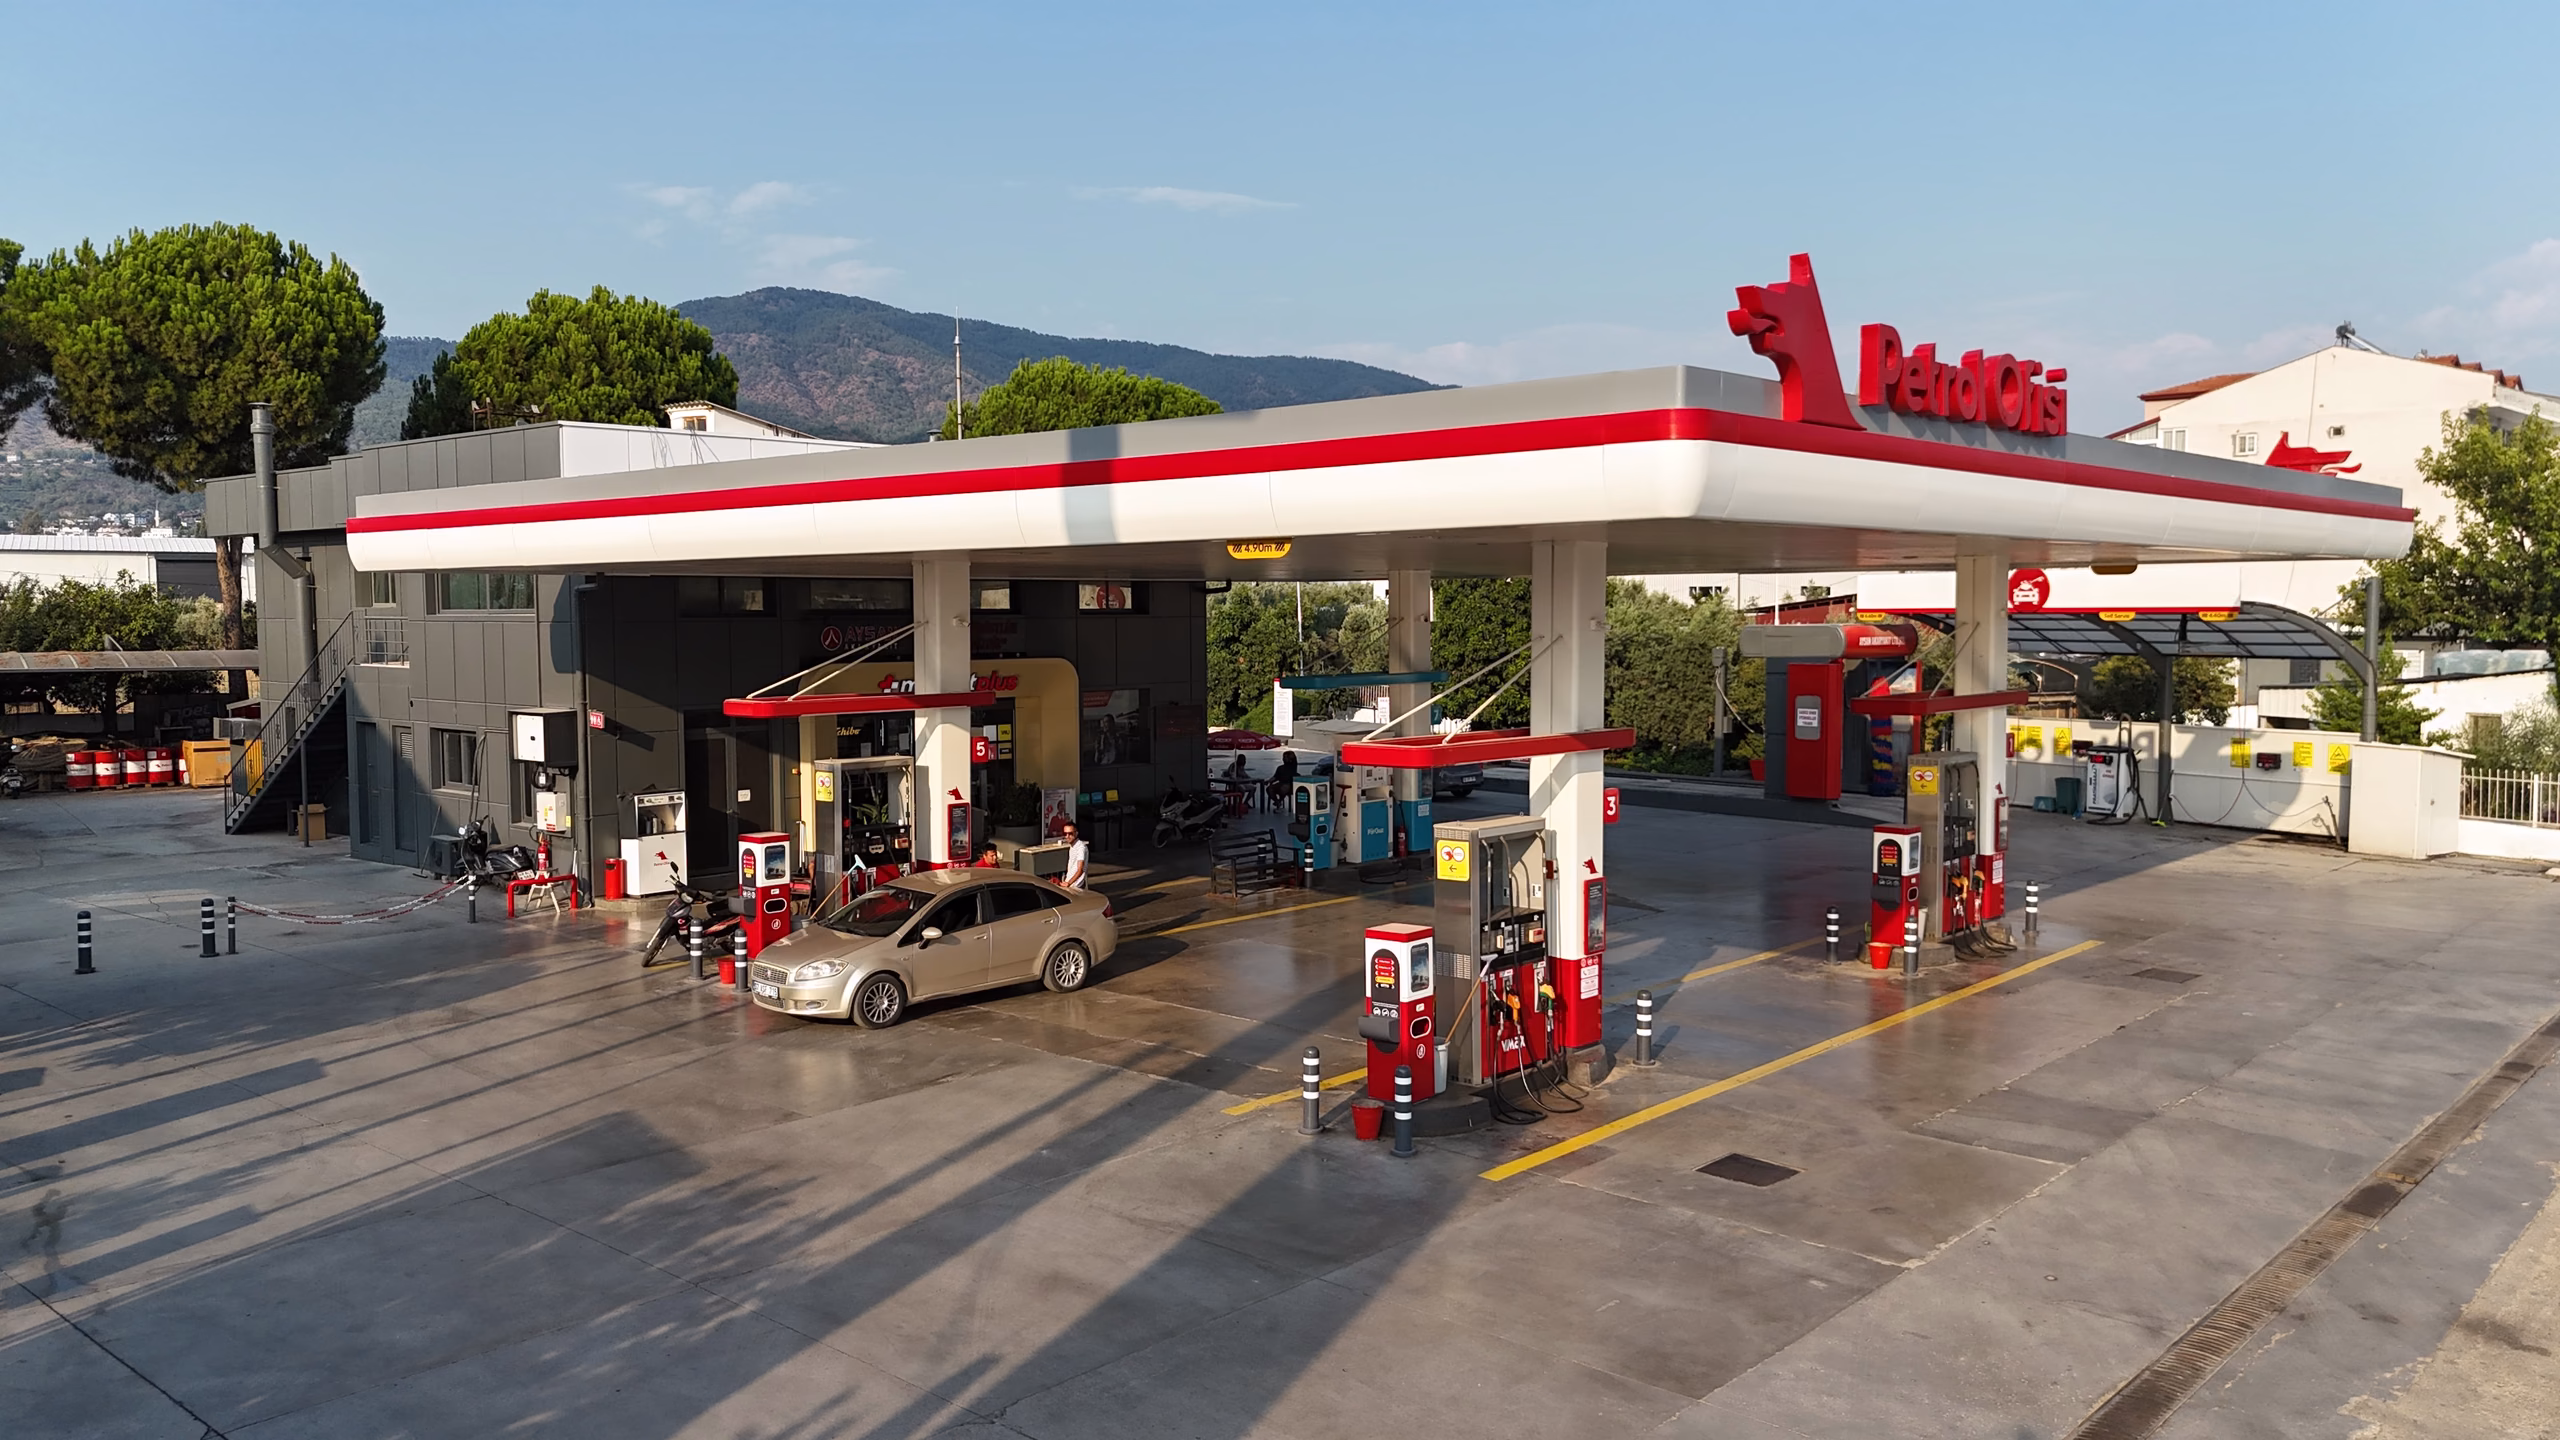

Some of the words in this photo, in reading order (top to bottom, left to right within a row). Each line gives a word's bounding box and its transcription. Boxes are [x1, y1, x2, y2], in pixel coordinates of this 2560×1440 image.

[1858, 323, 1986, 422] Petrol
[1984, 353, 2068, 437] Ofisi
[1244, 543, 1273, 553] 4.90m
[1433, 709, 1439, 721] 7
[976, 741, 986, 757] 5
[1606, 795, 1616, 816] 3
